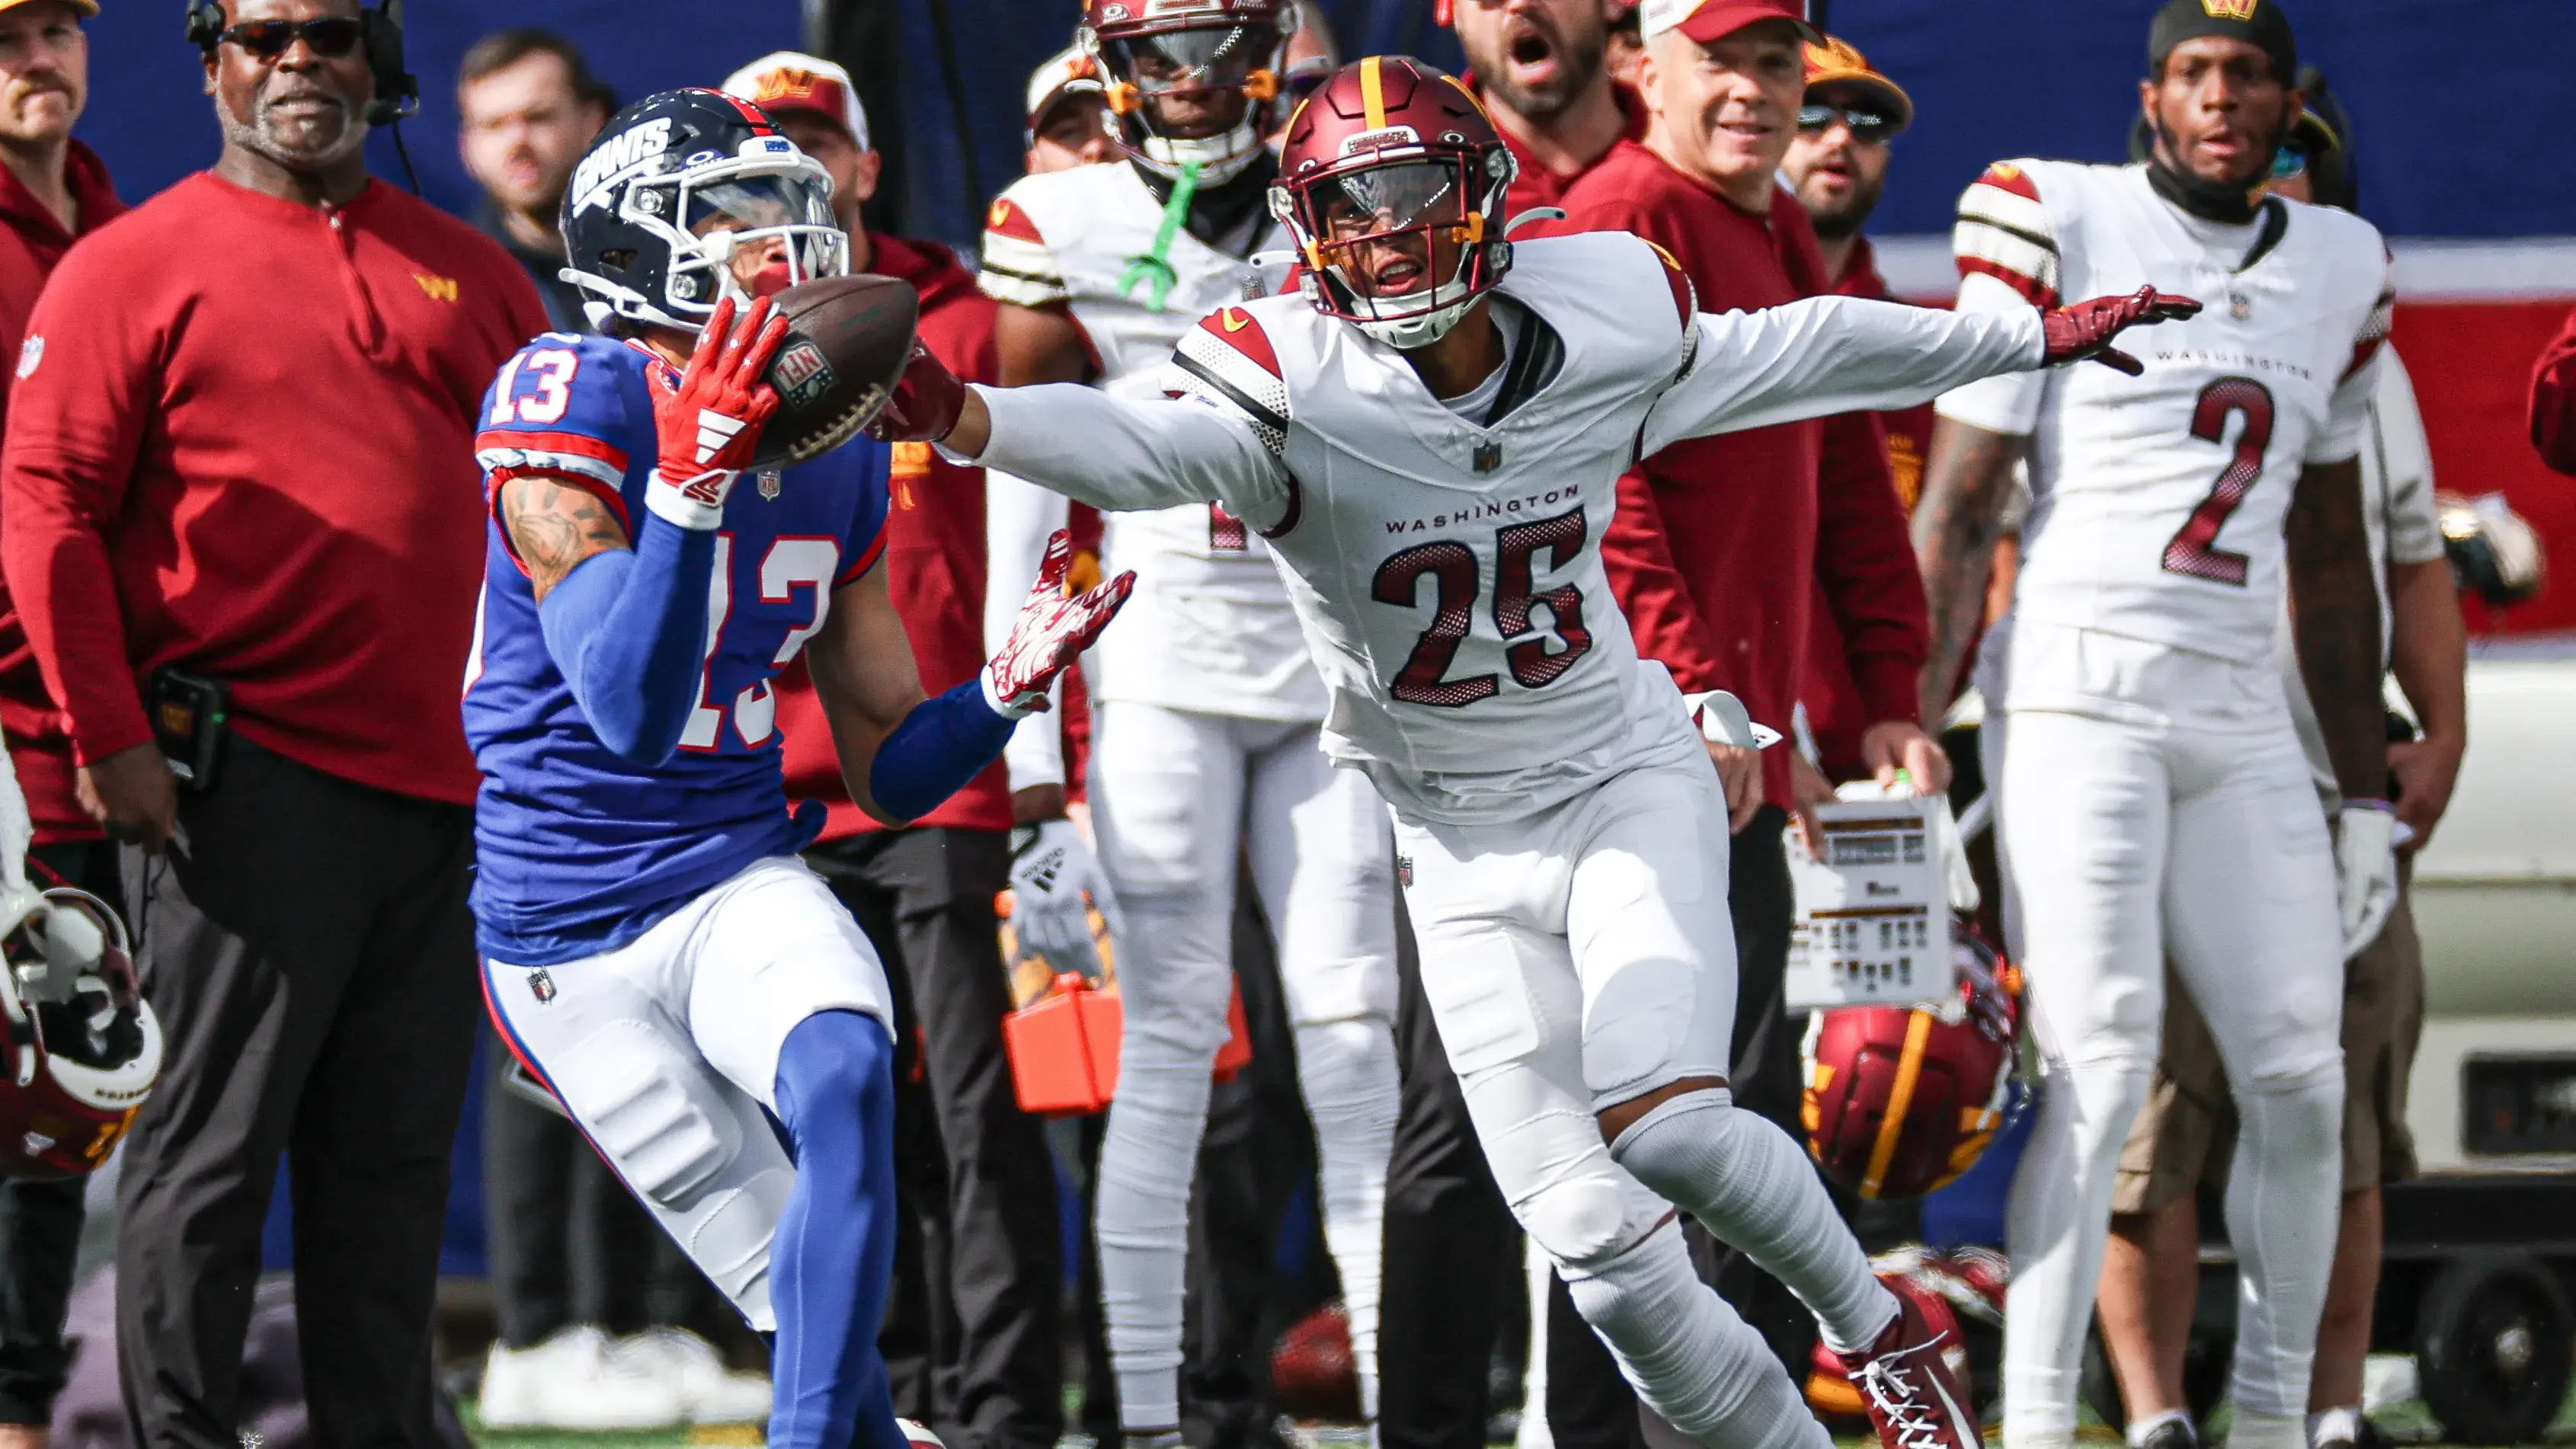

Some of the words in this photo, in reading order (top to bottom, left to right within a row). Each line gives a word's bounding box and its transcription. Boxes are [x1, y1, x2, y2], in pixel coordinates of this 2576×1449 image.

[571, 117, 670, 207] GIANTS
[489, 347, 580, 427] 13
[775, 345, 824, 390] NFL
[2156, 350, 2312, 381] WASHINGTON
[1385, 484, 1579, 535] WASHINGTON
[2162, 375, 2275, 587] 2
[1371, 503, 1593, 709] 25
